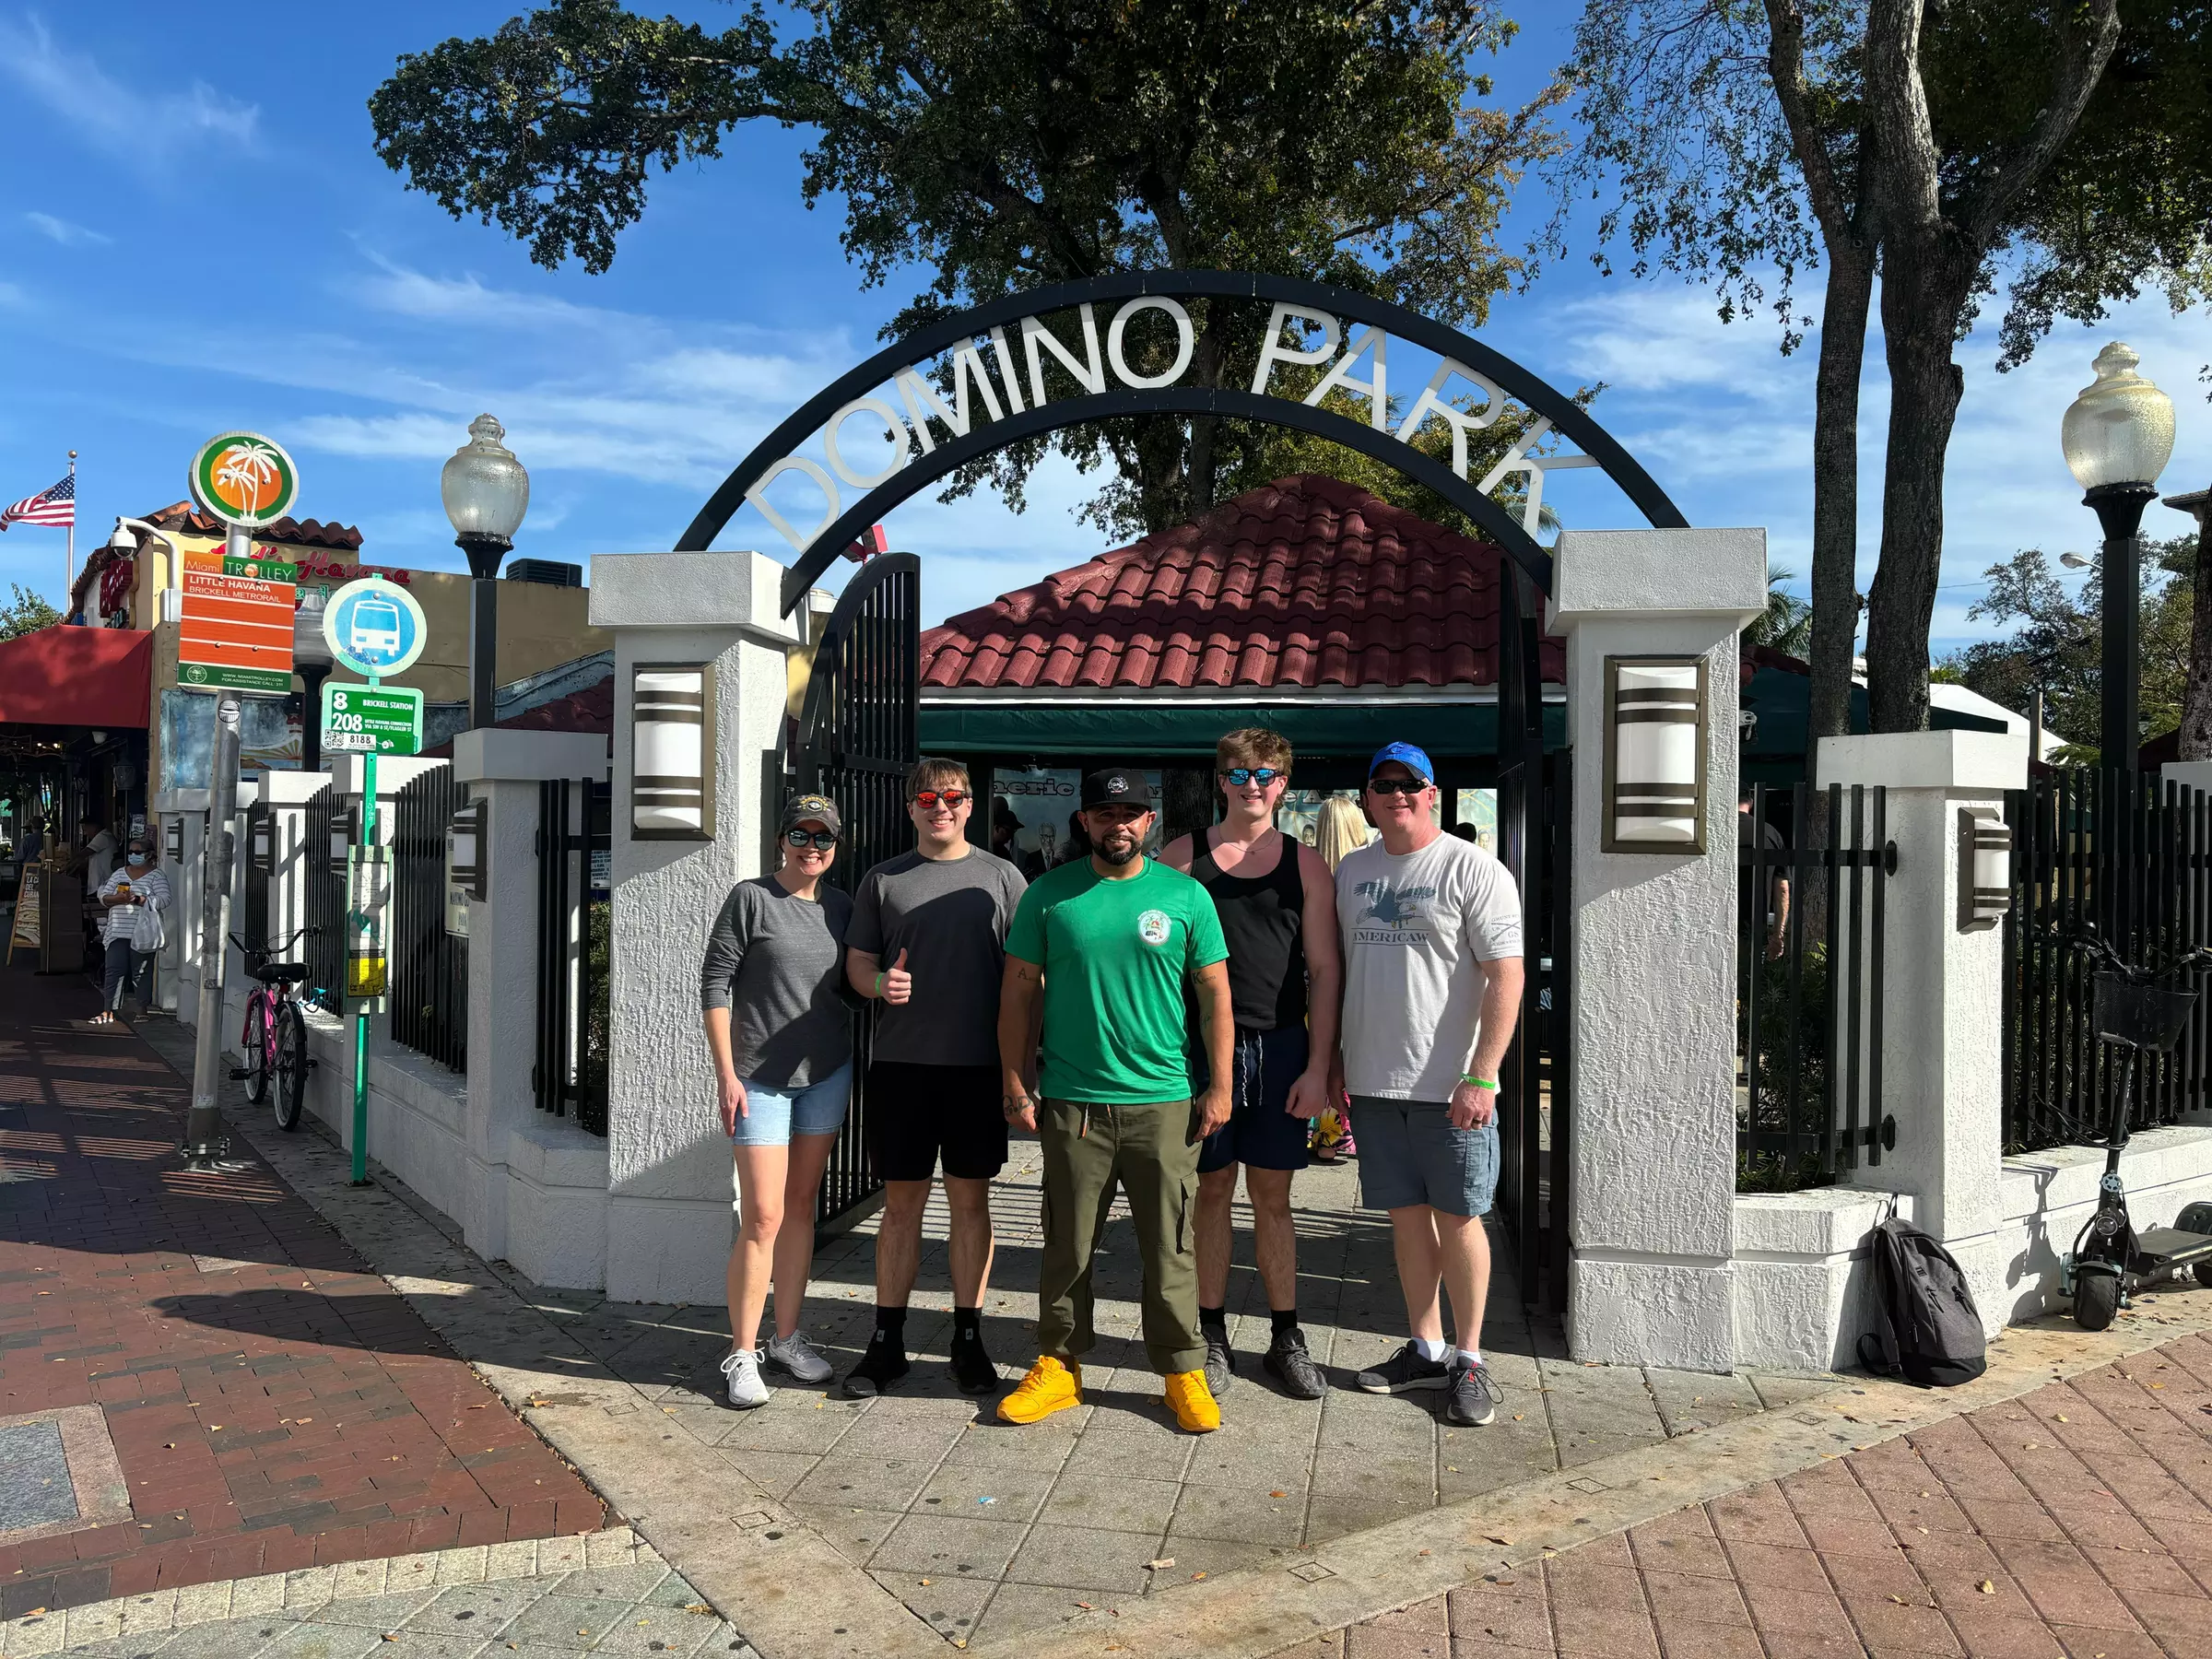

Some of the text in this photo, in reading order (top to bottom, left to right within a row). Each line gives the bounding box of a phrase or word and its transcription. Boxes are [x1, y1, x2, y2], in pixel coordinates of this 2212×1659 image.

[744, 295, 1602, 554] DOMINO PARK
[185, 560, 220, 572] Miami
[293, 550, 411, 585] Havana
[189, 575, 271, 593] LITTLE HAVANA
[189, 585, 230, 597] BRICKELL
[232, 591, 281, 603] METRORAIL
[333, 691, 348, 711] 8
[362, 699, 414, 711] BRICKELL STATION
[332, 712, 363, 733] 208
[349, 735, 371, 744] 8188
[25, 883, 34, 891] DEL
